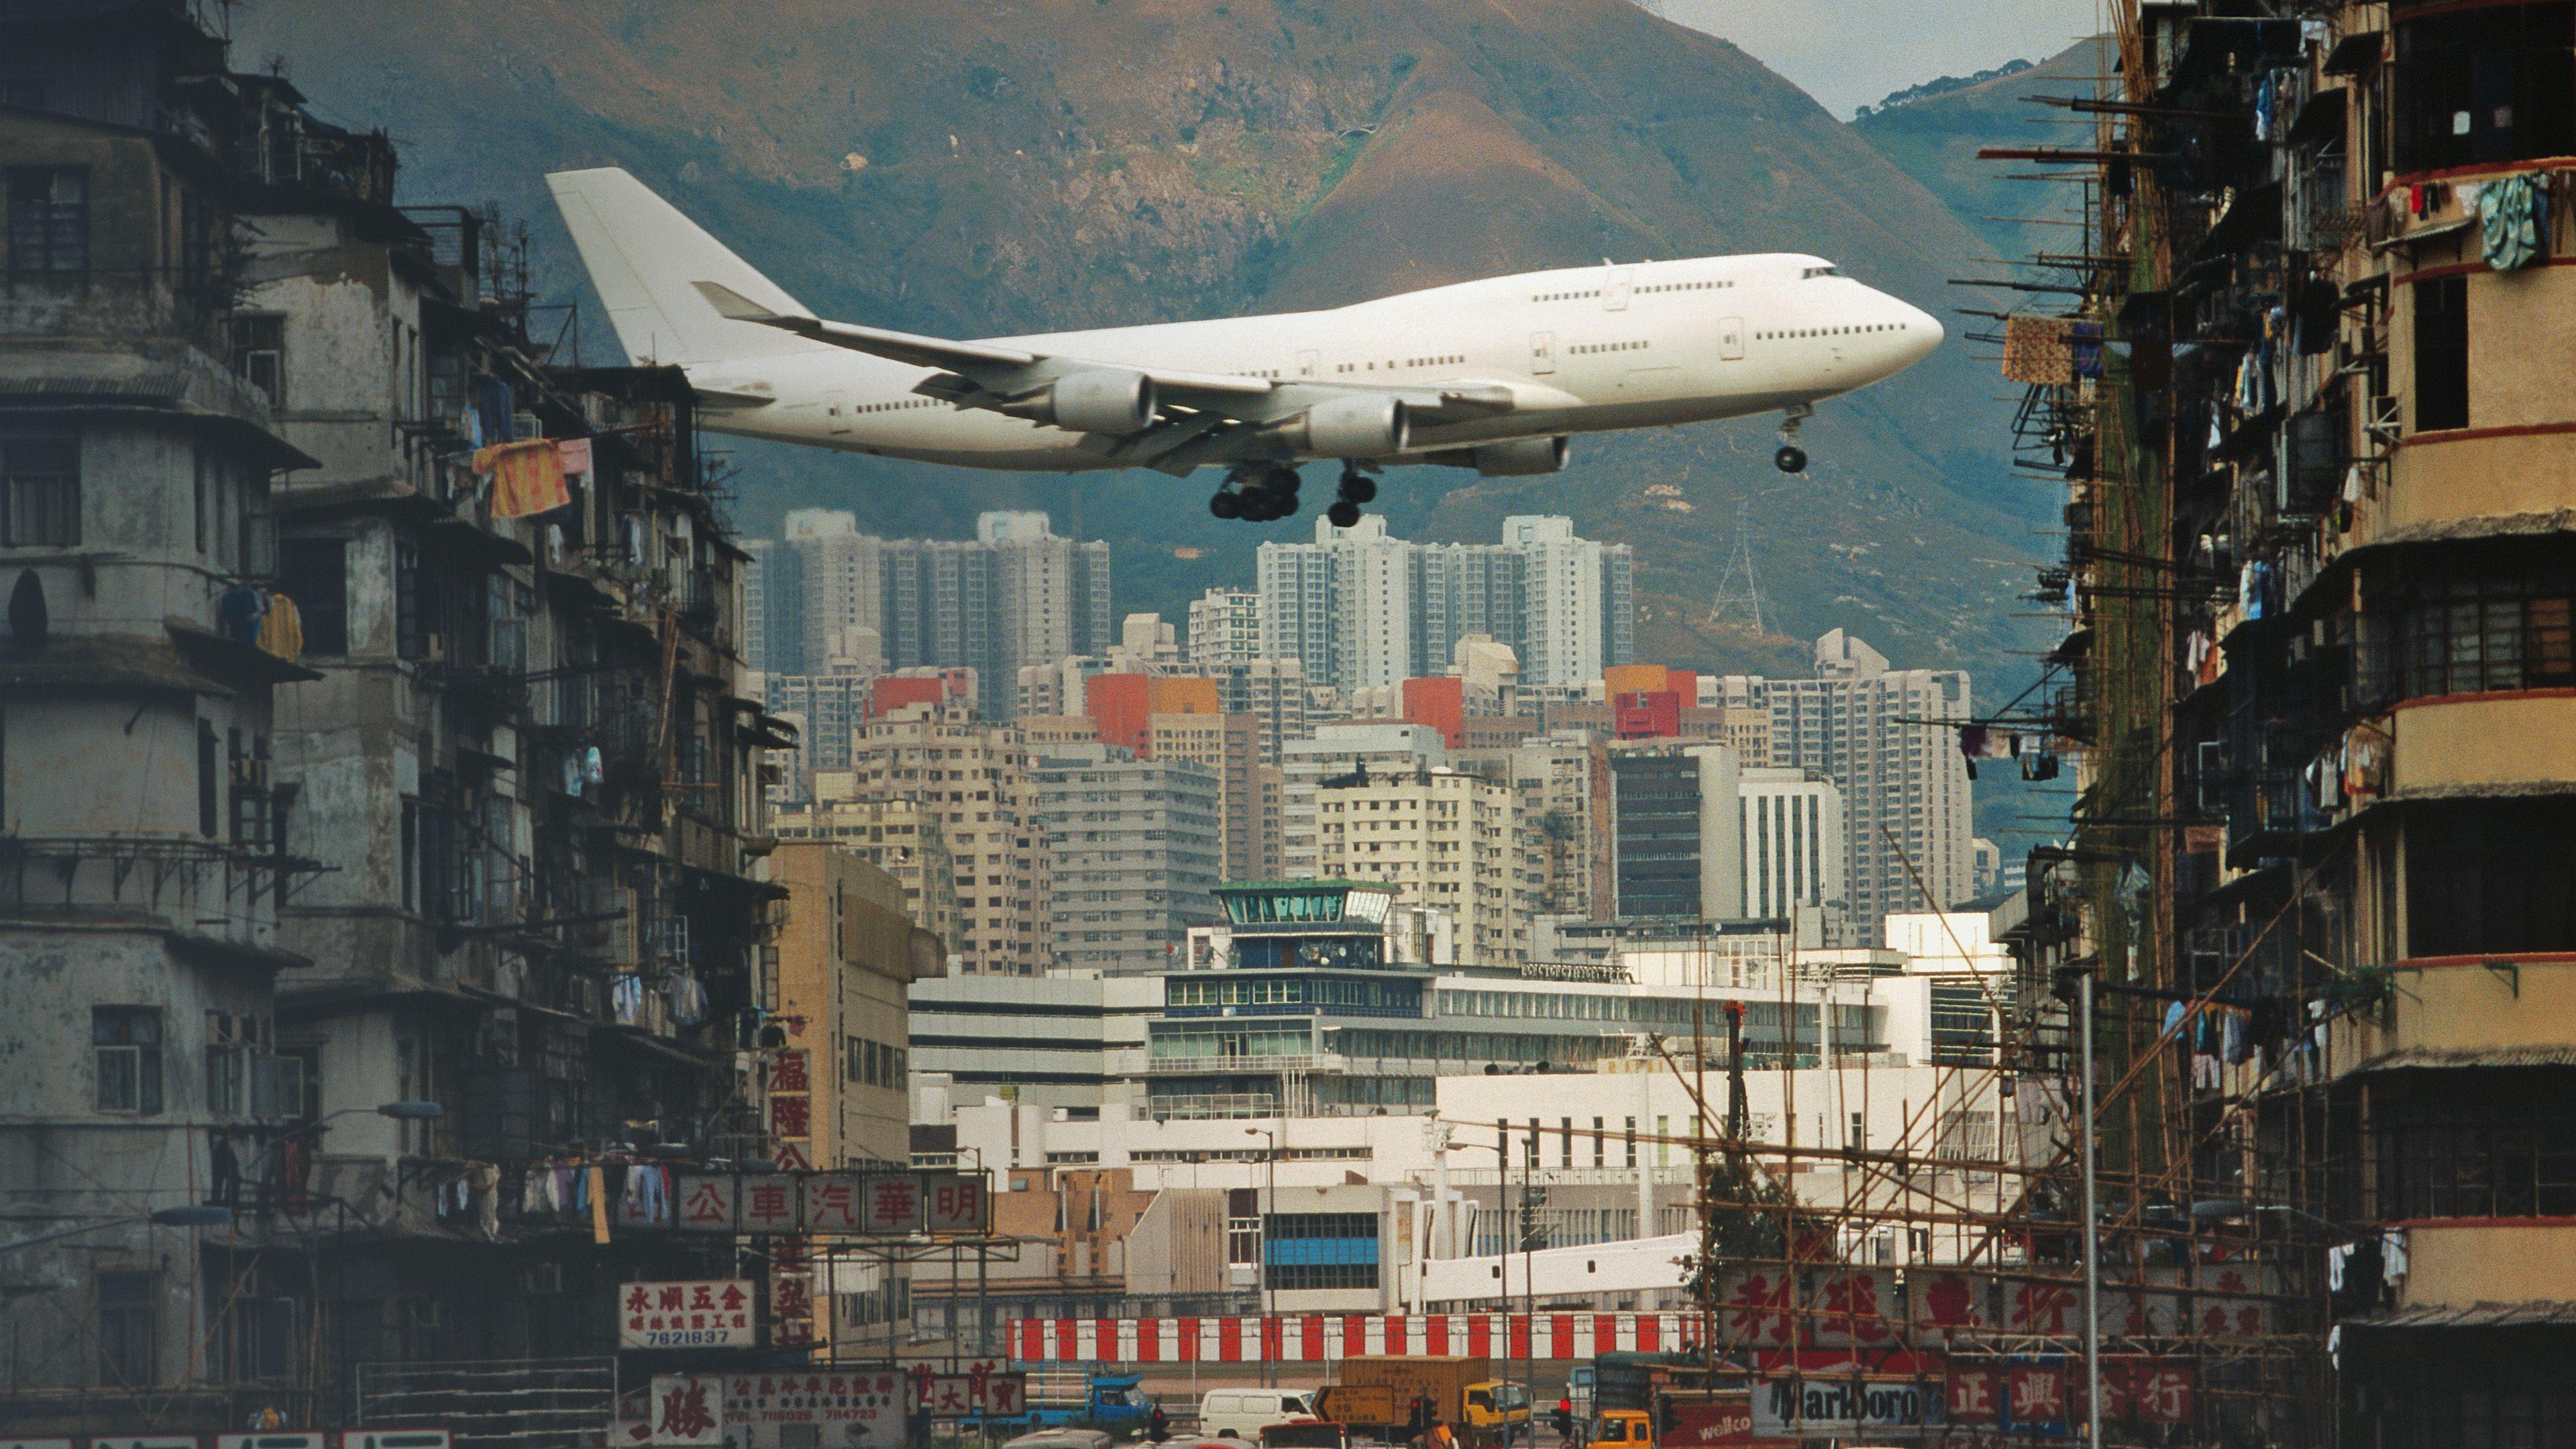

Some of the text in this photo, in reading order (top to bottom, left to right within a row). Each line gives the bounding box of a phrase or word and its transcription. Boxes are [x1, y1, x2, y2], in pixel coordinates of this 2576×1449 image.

[626, 1283, 747, 1313] 永順五金
[647, 1331, 730, 1346] 7621837
[1770, 1380, 1919, 1420] Marlboro
